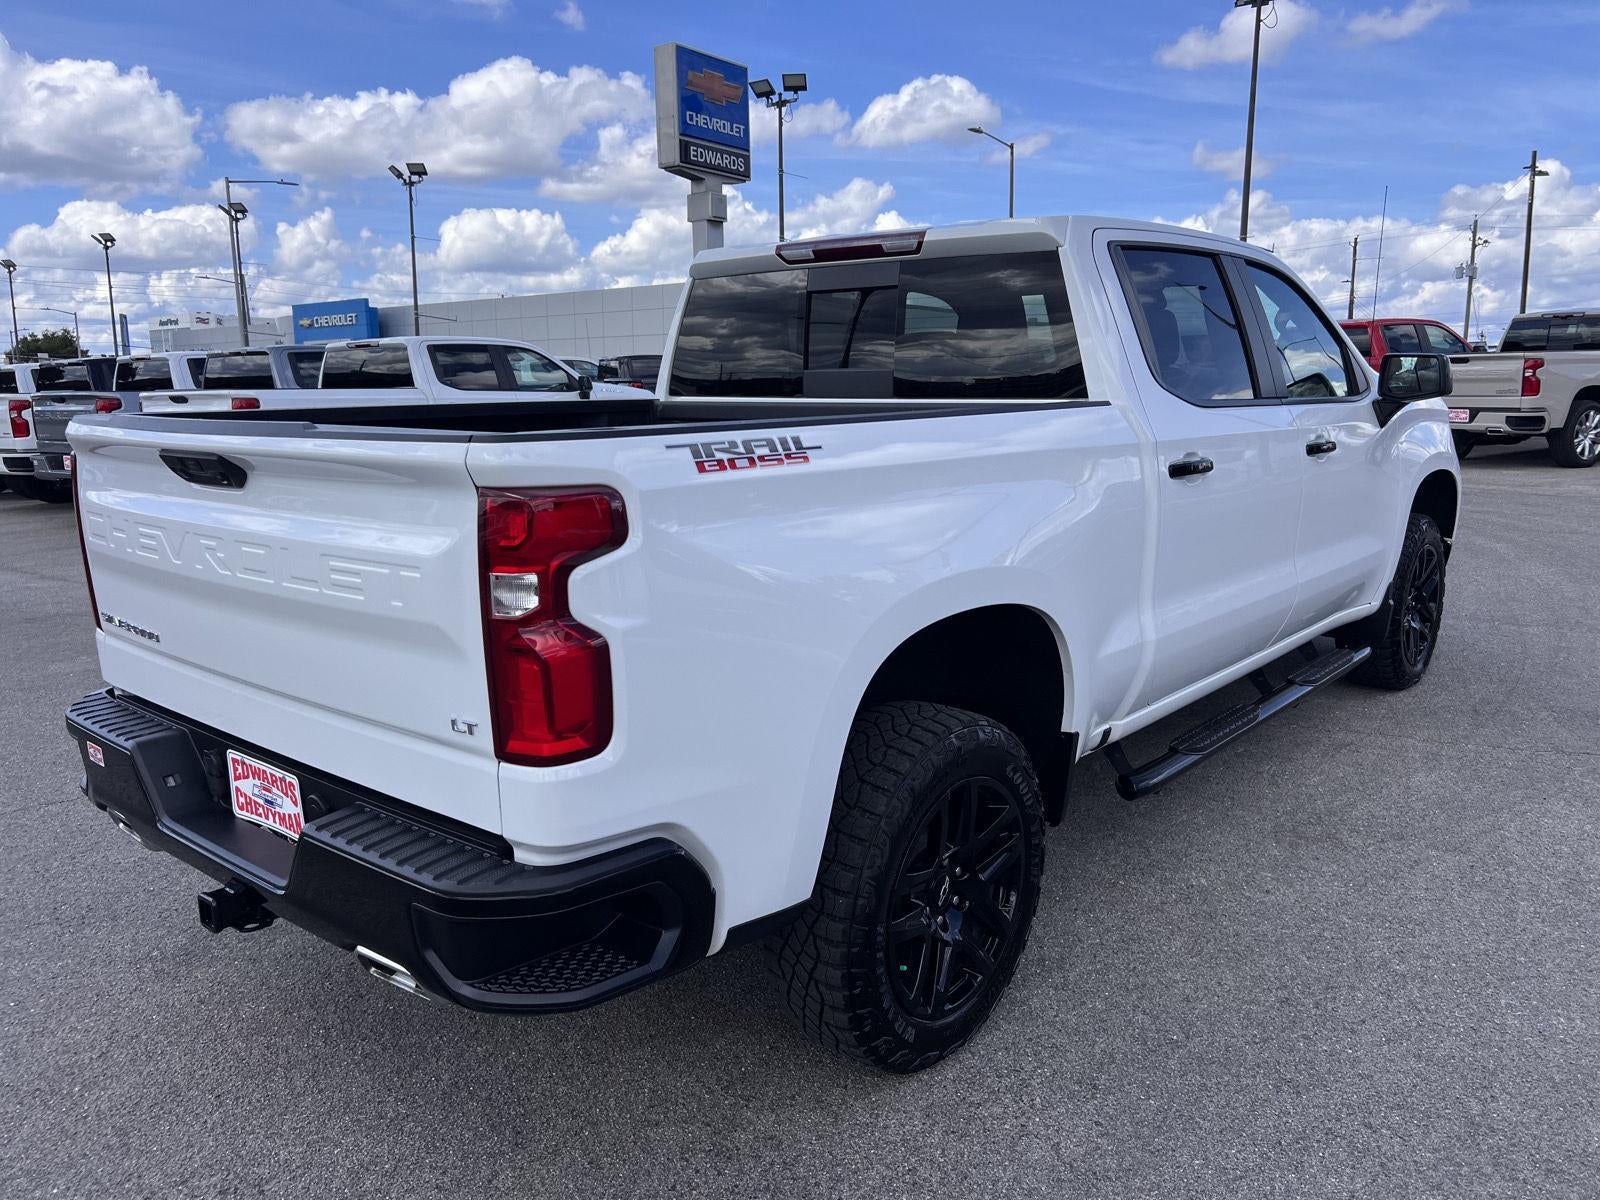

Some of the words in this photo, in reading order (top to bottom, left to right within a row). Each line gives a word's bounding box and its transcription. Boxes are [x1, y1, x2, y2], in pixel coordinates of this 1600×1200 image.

[686, 111, 745, 138] CHEVROLET
[690, 146, 745, 171] EDWARDS
[313, 313, 357, 328] CHEVROLET
[665, 435, 822, 460] TRAIL
[695, 451, 810, 474] BOSS
[86, 511, 421, 606] CHEVROLET
[451, 719, 478, 735] LT
[231, 757, 299, 808] EDWARDS
[234, 786, 303, 836] CHEVYMAN
